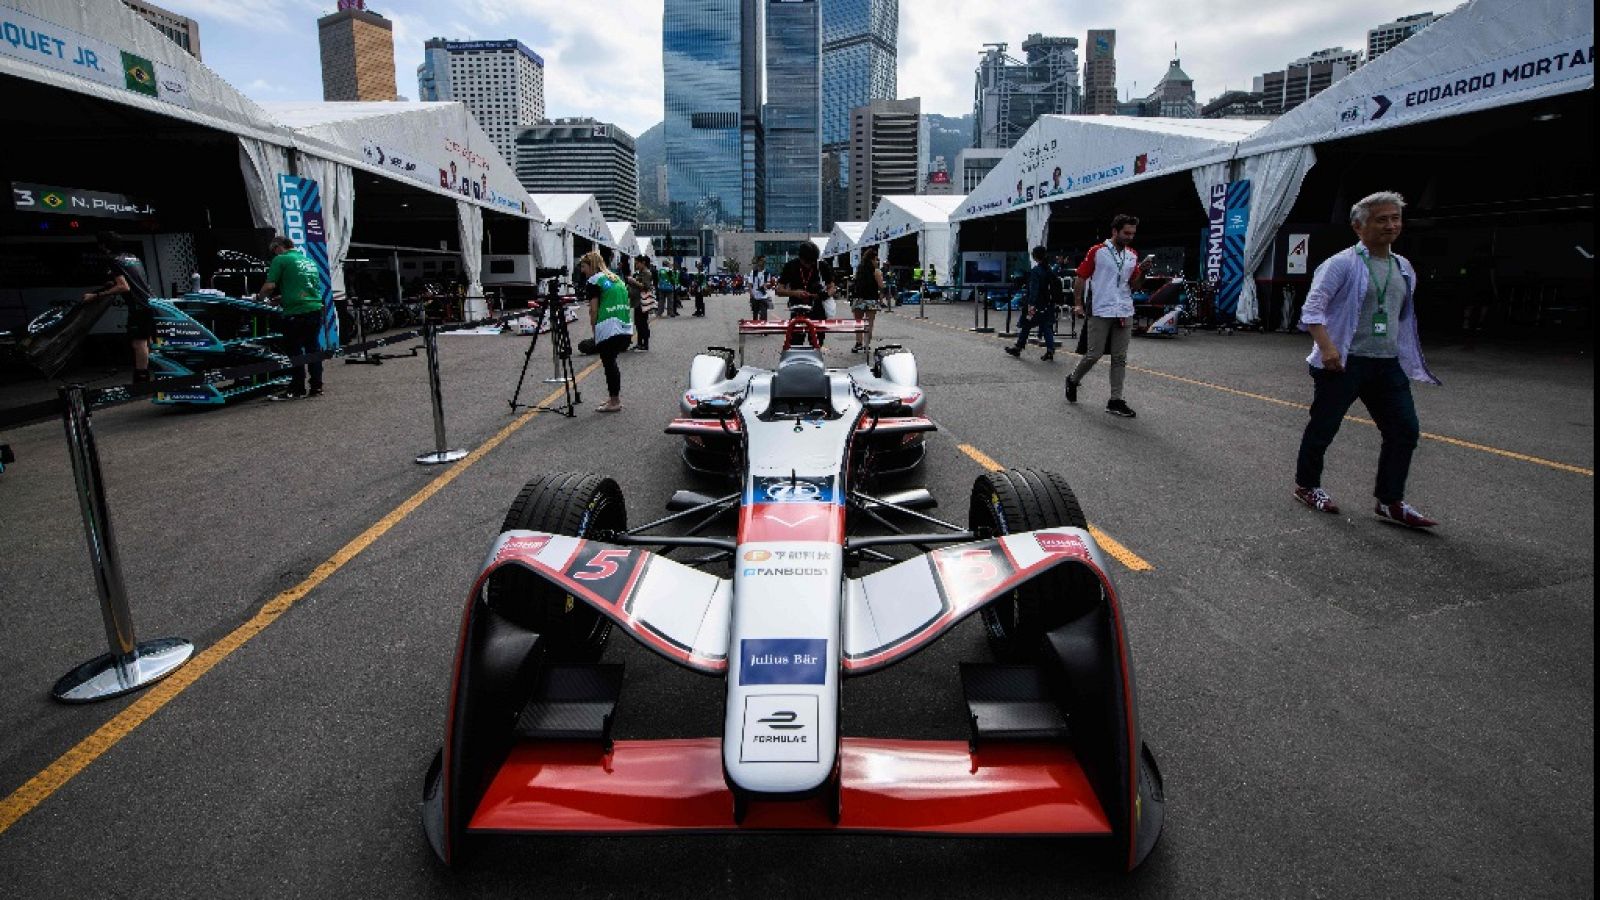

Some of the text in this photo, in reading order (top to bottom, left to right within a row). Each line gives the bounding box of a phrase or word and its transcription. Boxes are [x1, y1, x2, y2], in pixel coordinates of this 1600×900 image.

[73, 46, 105, 73] JR.
[13, 188, 35, 207] 3
[71, 196, 90, 209] N.
[1206, 183, 1229, 289] ORMULAE
[573, 549, 632, 581] 5
[959, 549, 997, 581] 5
[750, 654, 818, 667] Julius Bär
